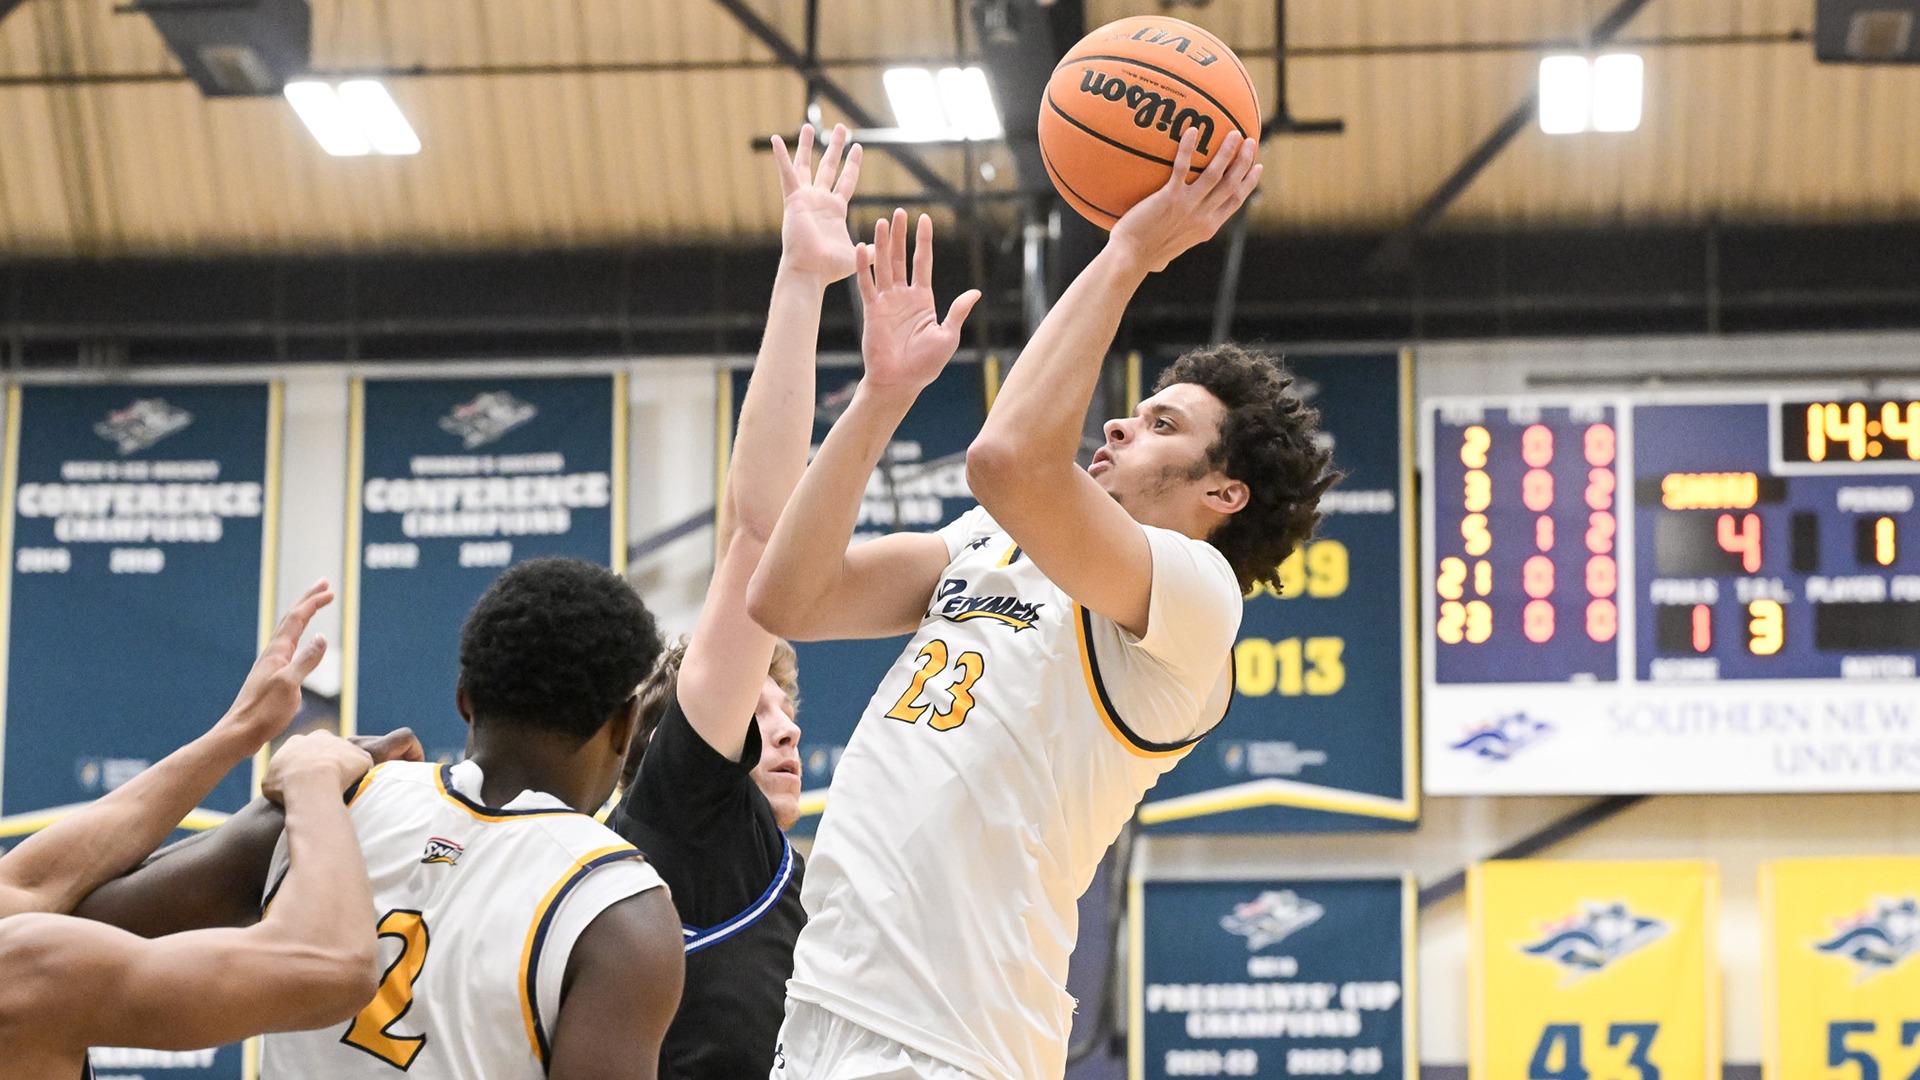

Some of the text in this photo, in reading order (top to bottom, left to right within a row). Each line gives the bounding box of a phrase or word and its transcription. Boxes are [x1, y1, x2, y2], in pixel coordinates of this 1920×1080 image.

[1139, 76, 1159, 87] GAME
[1160, 84, 1187, 99] INDOOR
[1079, 69, 1215, 157] Wilson
[1461, 426, 1491, 469] 2
[18, 482, 262, 517] CONFERENCE
[364, 473, 609, 512] CONFERENCE
[1464, 469, 1492, 512] 3
[1585, 468, 1616, 511] 2
[54, 516, 223, 543] CHAMPIONS
[402, 508, 571, 537] CHAMPIONS
[1461, 511, 1616, 556] 5 1 2
[1717, 513, 1761, 573] 4
[1875, 517, 1895, 566] 1
[925, 578, 1045, 622] PENMEN
[1437, 557, 1492, 600] 21
[1437, 600, 1492, 644] 23
[1692, 603, 1711, 653] 1
[1749, 599, 1783, 655] 3
[884, 639, 984, 732] 23
[1234, 636, 1345, 697] 013
[1608, 701, 1914, 733] SOUTHERN NEW
[340, 909, 430, 1072] 2
[1147, 982, 1400, 1012] PRESIDENTS' CUP
[1186, 1010, 1361, 1038] CHAMPIONS
[1528, 1022, 1661, 1080] 43
